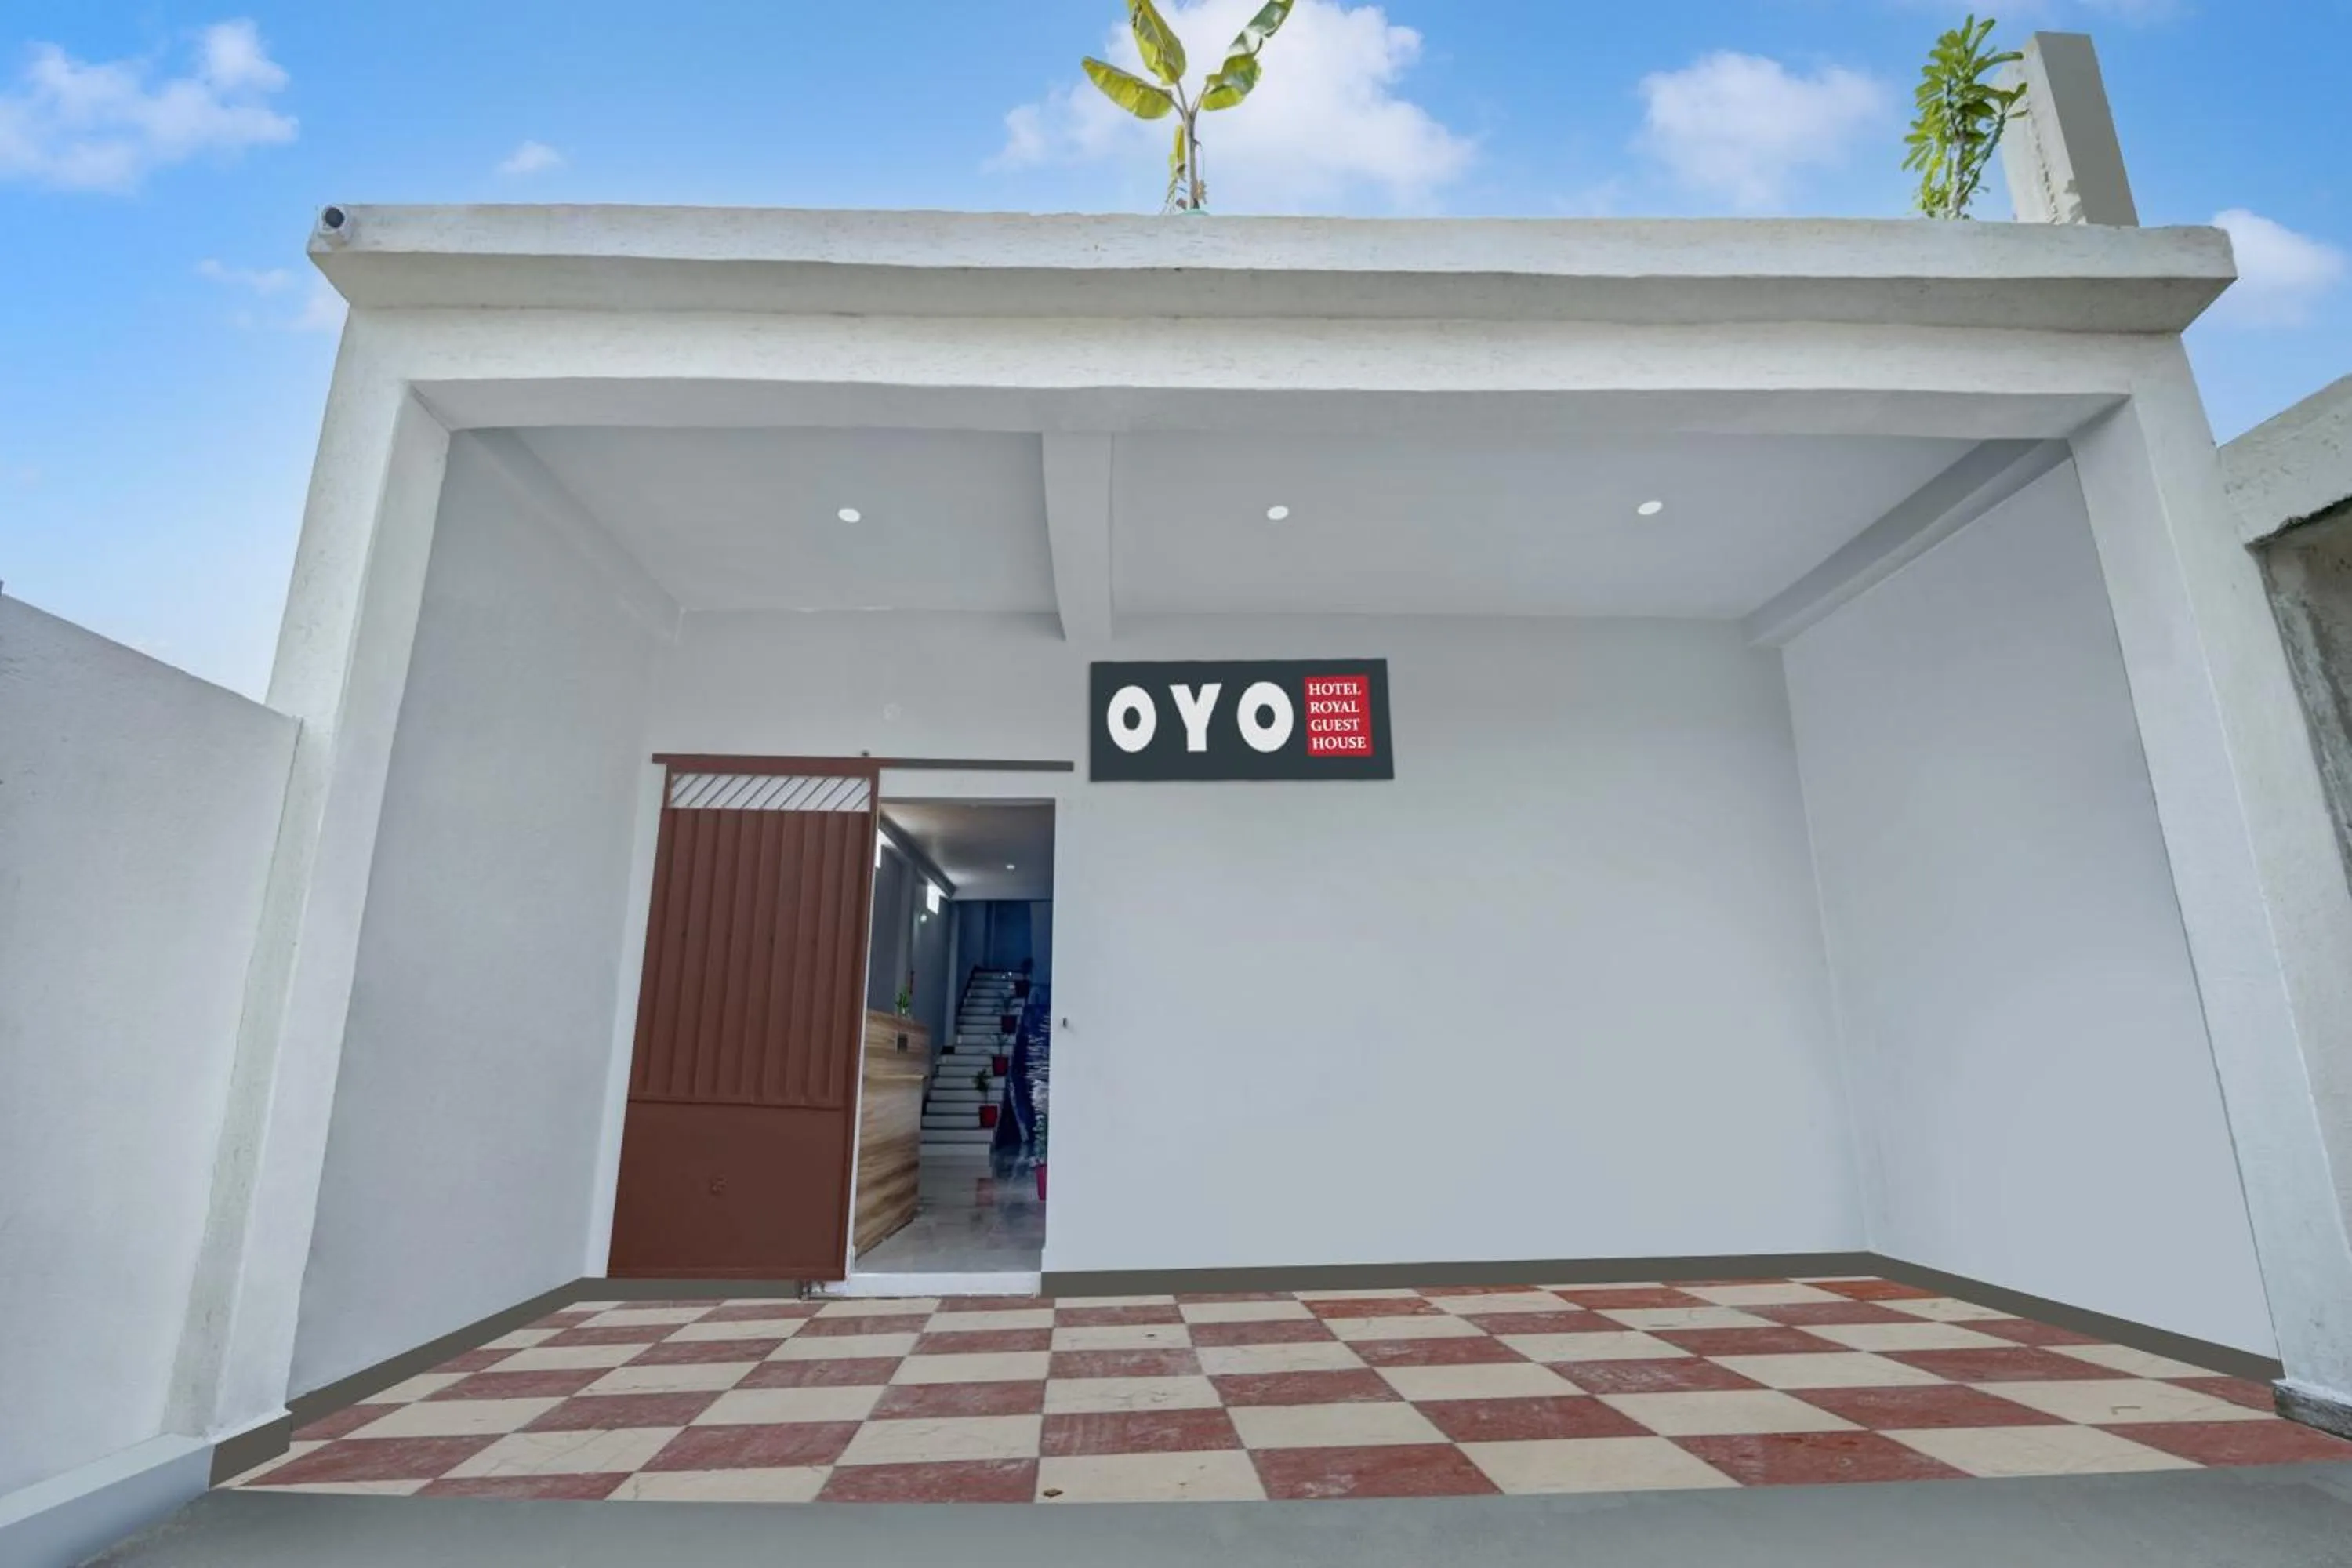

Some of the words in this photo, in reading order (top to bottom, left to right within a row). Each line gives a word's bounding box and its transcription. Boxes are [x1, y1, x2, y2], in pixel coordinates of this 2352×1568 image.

[1308, 682, 1361, 695] HOTEL
[1310, 700, 1359, 713] ROYAL
[1106, 681, 1294, 753] OYO
[1310, 718, 1360, 731] GUEST
[1312, 736, 1367, 750] HOUSE
